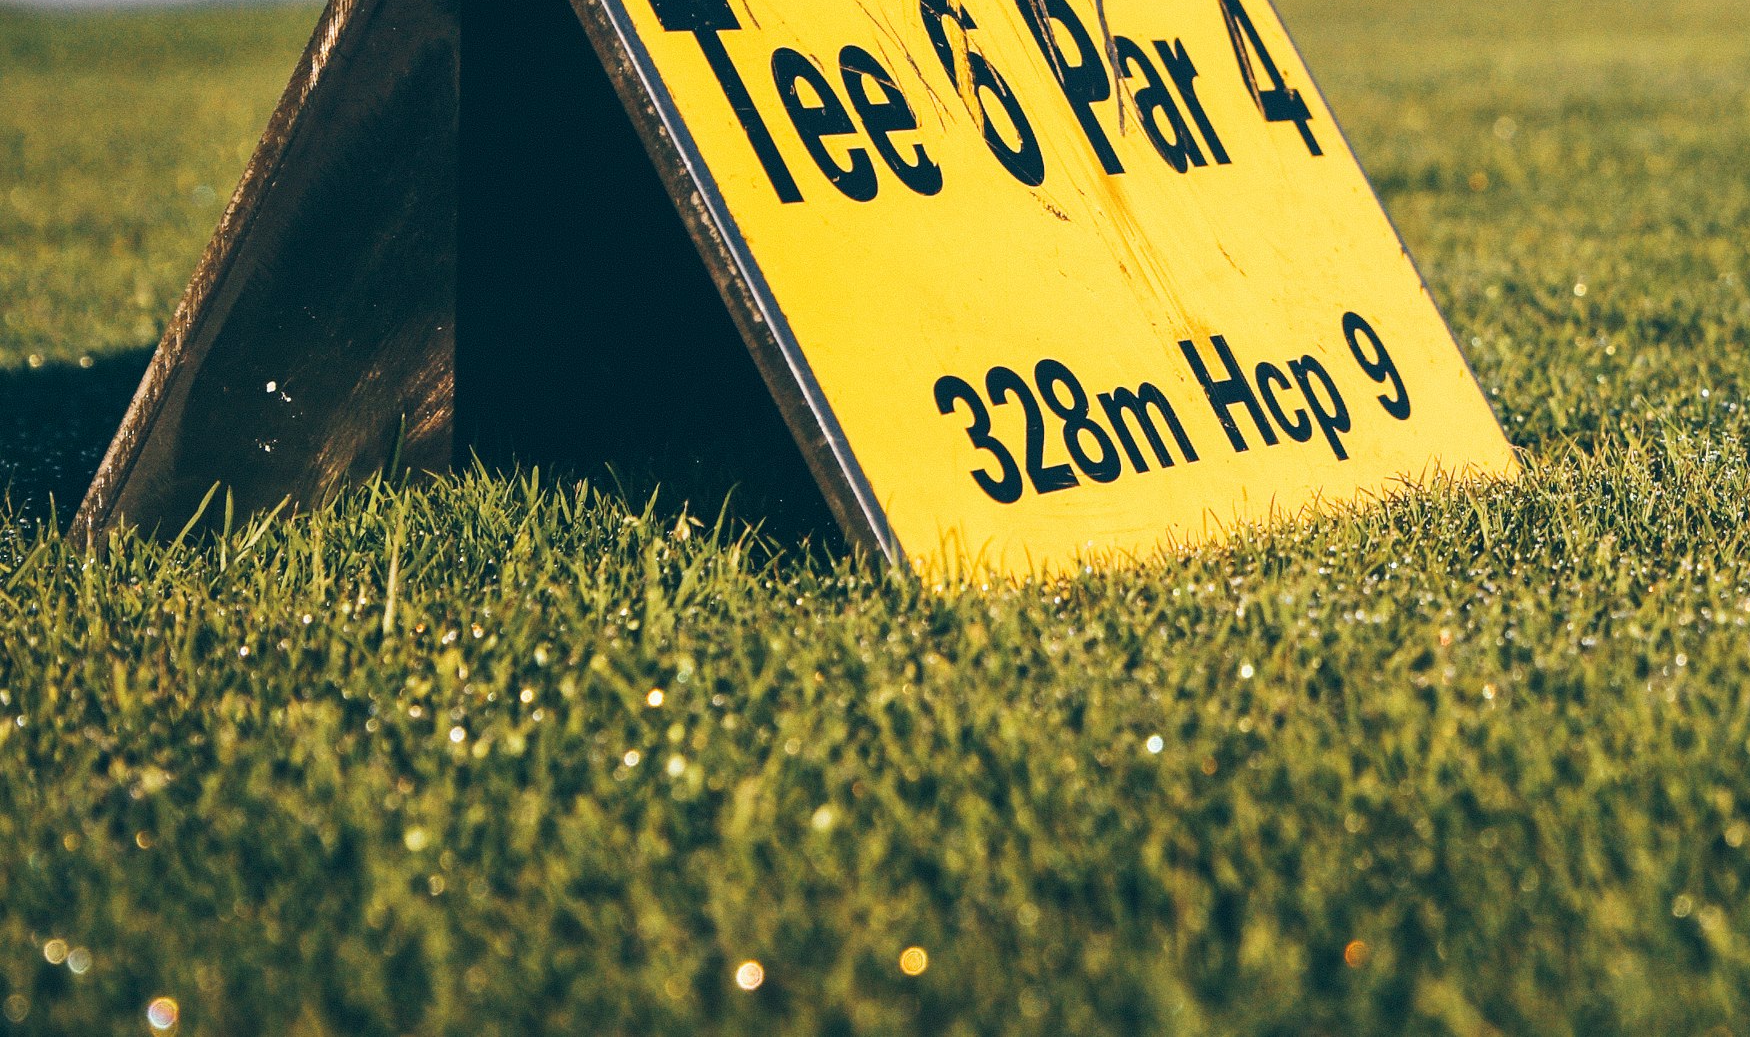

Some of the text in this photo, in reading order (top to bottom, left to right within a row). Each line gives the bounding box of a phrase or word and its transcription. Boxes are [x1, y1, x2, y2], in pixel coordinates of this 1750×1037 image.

[933, 311, 1412, 505] 328m Hcp 9
